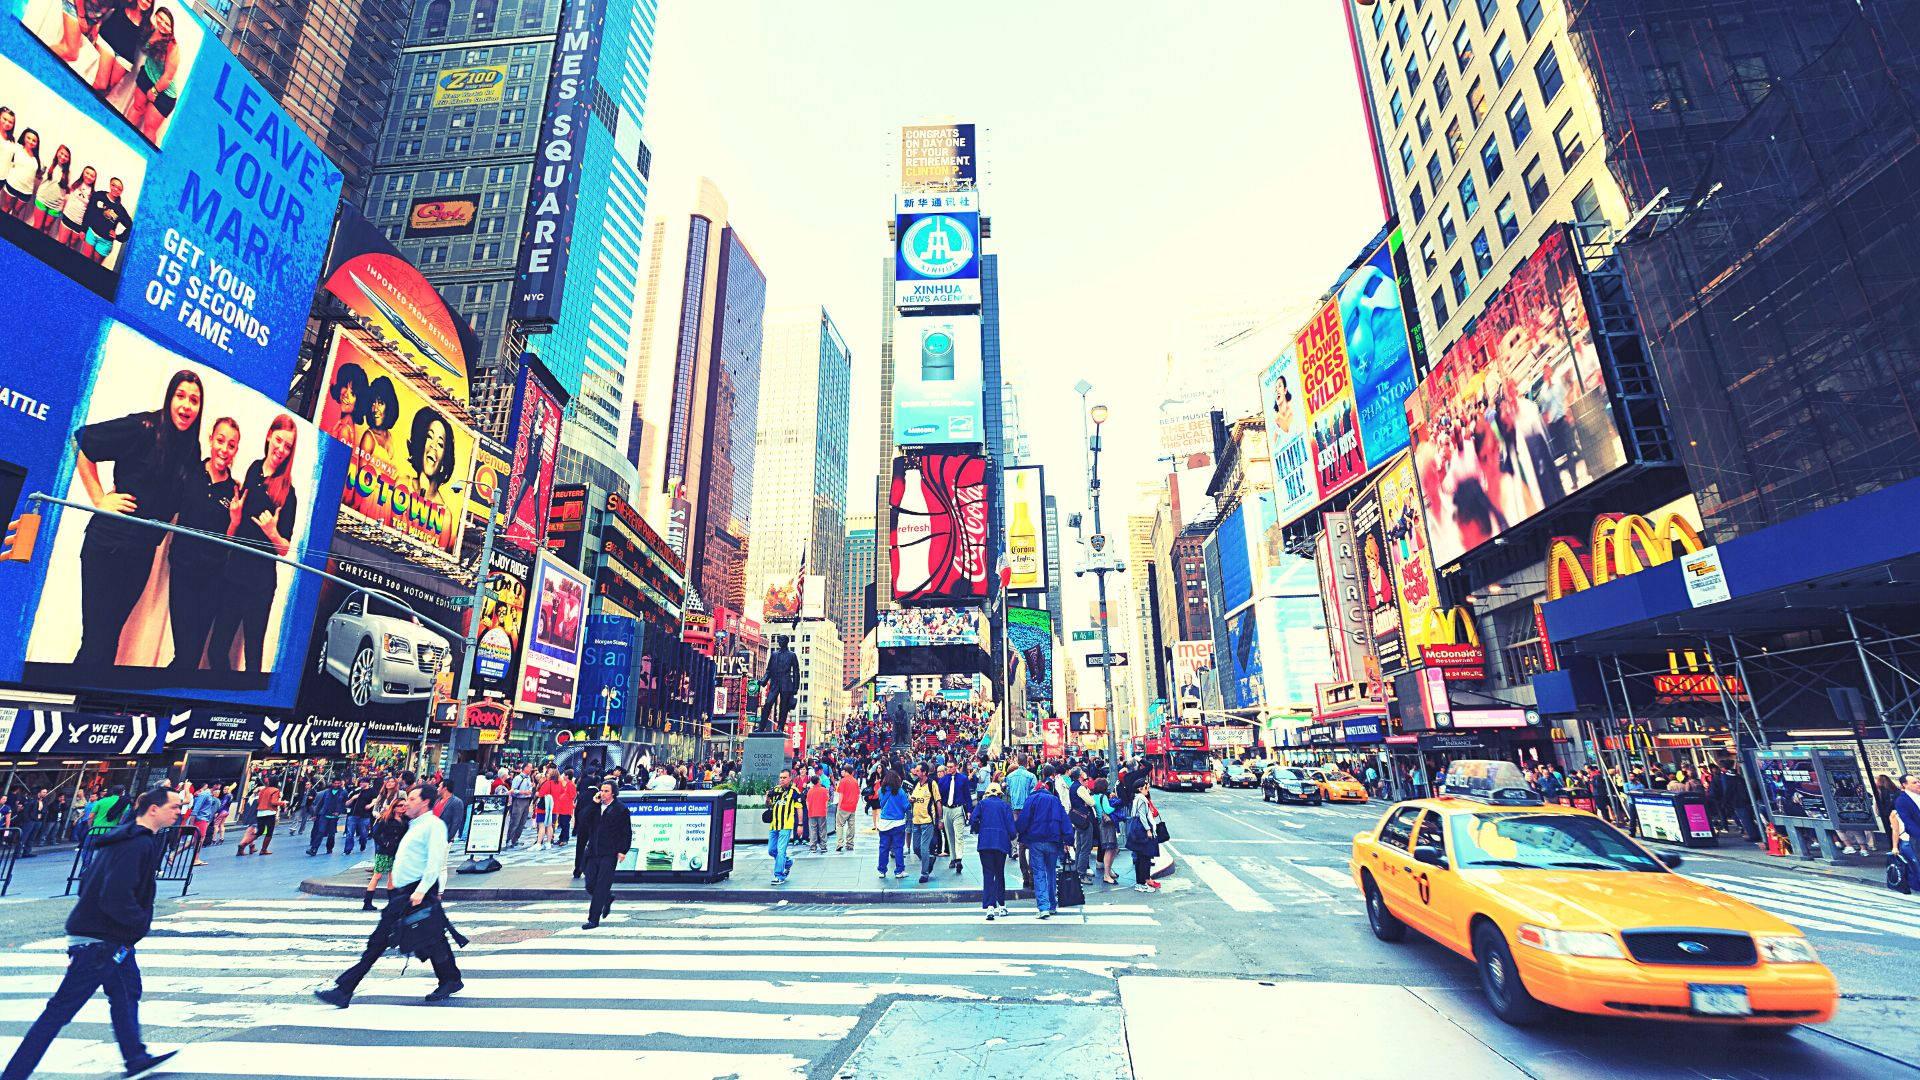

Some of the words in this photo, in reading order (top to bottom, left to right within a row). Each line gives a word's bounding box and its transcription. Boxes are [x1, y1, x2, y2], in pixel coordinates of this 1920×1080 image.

[559, 0, 589, 101] IMES
[447, 71, 498, 90] Z100
[212, 61, 321, 195] LEAVE
[905, 129, 960, 139] CONGRATS
[905, 139, 920, 148] ON
[922, 138, 945, 147] DAY
[945, 137, 966, 147] ONE
[905, 148, 919, 157] OF
[922, 147, 948, 156] YOUR
[905, 166, 949, 177] CLINTON
[216, 123, 306, 244] YOUR
[528, 114, 572, 273] SQUARE
[178, 169, 294, 291] MARK
[163, 227, 205, 266] GET
[208, 263, 258, 312] YOUR
[366, 264, 407, 305] IMPORTED
[408, 303, 428, 325] FROM
[523, 293, 545, 303] NYC
[914, 284, 961, 294] XINHUA
[157, 253, 183, 287] 15
[185, 275, 271, 348] SECONDS
[902, 295, 931, 303] NEWS
[145, 280, 176, 314] OF
[178, 303, 234, 355] FAME.
[1297, 302, 1337, 358] THE
[1302, 330, 1341, 375] CROWD
[1303, 346, 1345, 394] GOES
[1307, 366, 1349, 415] WILD!
[1361, 376, 1413, 424] PHANTOM
[1188, 420, 1212, 431] BES
[1183, 438, 1212, 447] CENTU
[354, 447, 397, 476] BROADWAY
[478, 448, 511, 476] venue
[555, 489, 585, 498] REUTERS
[897, 524, 930, 533] refresh
[1011, 546, 1035, 554] Corona
[489, 551, 496, 566] A
[495, 553, 511, 571] JOY
[339, 561, 383, 584] CHRYSLER
[385, 580, 400, 590] 300
[403, 586, 434, 602] MOTOWN
[436, 598, 461, 612] EDITON
[1336, 522, 1366, 645] PALACE
[1426, 650, 1483, 659] McDonald's
[709, 655, 746, 675] HEY'S
[306, 715, 360, 728] Chrysler.com
[368, 721, 441, 734] MotownTheMusic.com
[468, 707, 503, 728] ROXY
[92, 723, 125, 735] WE'RE
[193, 728, 228, 740] ENTER
[228, 729, 255, 741] HERE
[322, 731, 340, 740] WE'RE
[87, 734, 118, 745] OPEN
[320, 739, 337, 747] OPEN
[688, 804, 709, 812] Clean!
